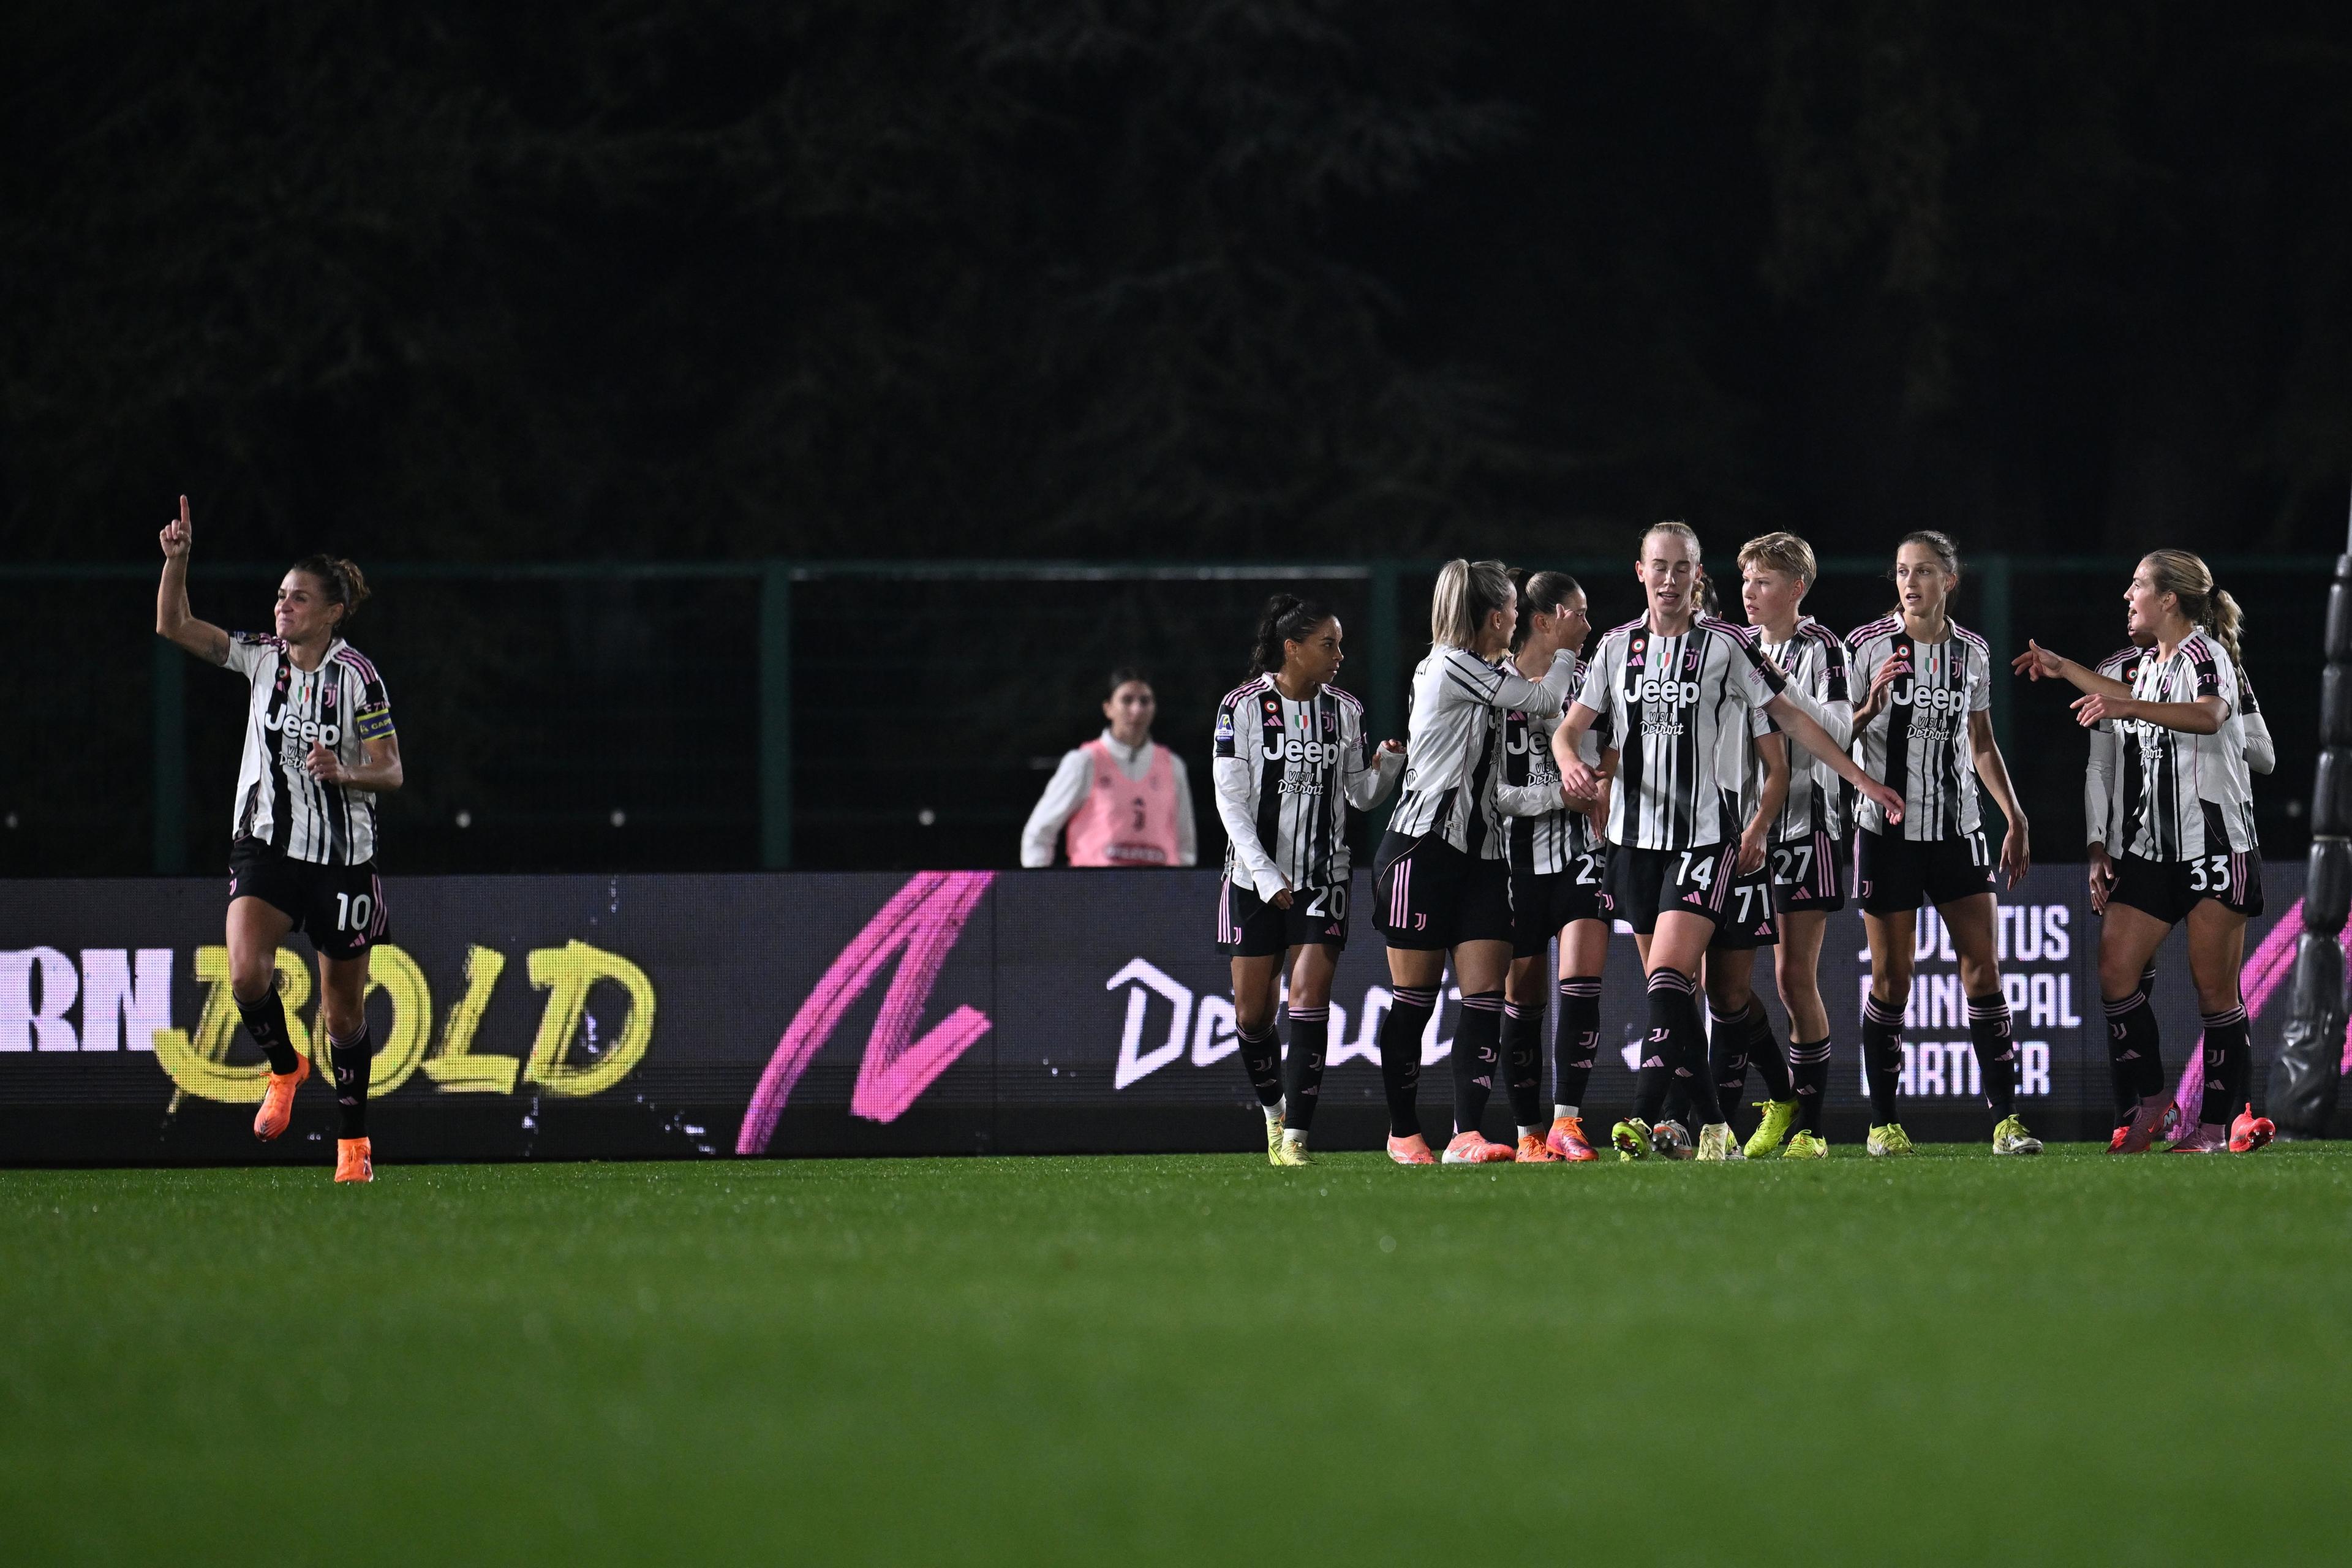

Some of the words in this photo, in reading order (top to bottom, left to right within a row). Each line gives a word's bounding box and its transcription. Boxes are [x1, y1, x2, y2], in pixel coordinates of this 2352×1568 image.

[1623, 674, 1701, 709] Jeep
[1891, 678, 1964, 717] Jeep
[264, 703, 341, 750] Jeep
[1640, 720, 1684, 737] Detroit
[1649, 712, 1674, 722] VISIT
[1906, 723, 1950, 741] Detroit
[1918, 717, 1943, 728] VISIT
[287, 745, 307, 760] VISI
[1262, 733, 1339, 769] Jeep
[1506, 726, 1549, 756] Je
[1277, 778, 1324, 796] Detroit
[1289, 771, 1315, 783] VISIT
[1675, 851, 1714, 891] 14
[1773, 845, 1813, 885] 27
[2190, 854, 2231, 891] 33
[336, 892, 371, 932] 10
[1306, 884, 1346, 921] 20
[1734, 883, 1771, 924] 71
